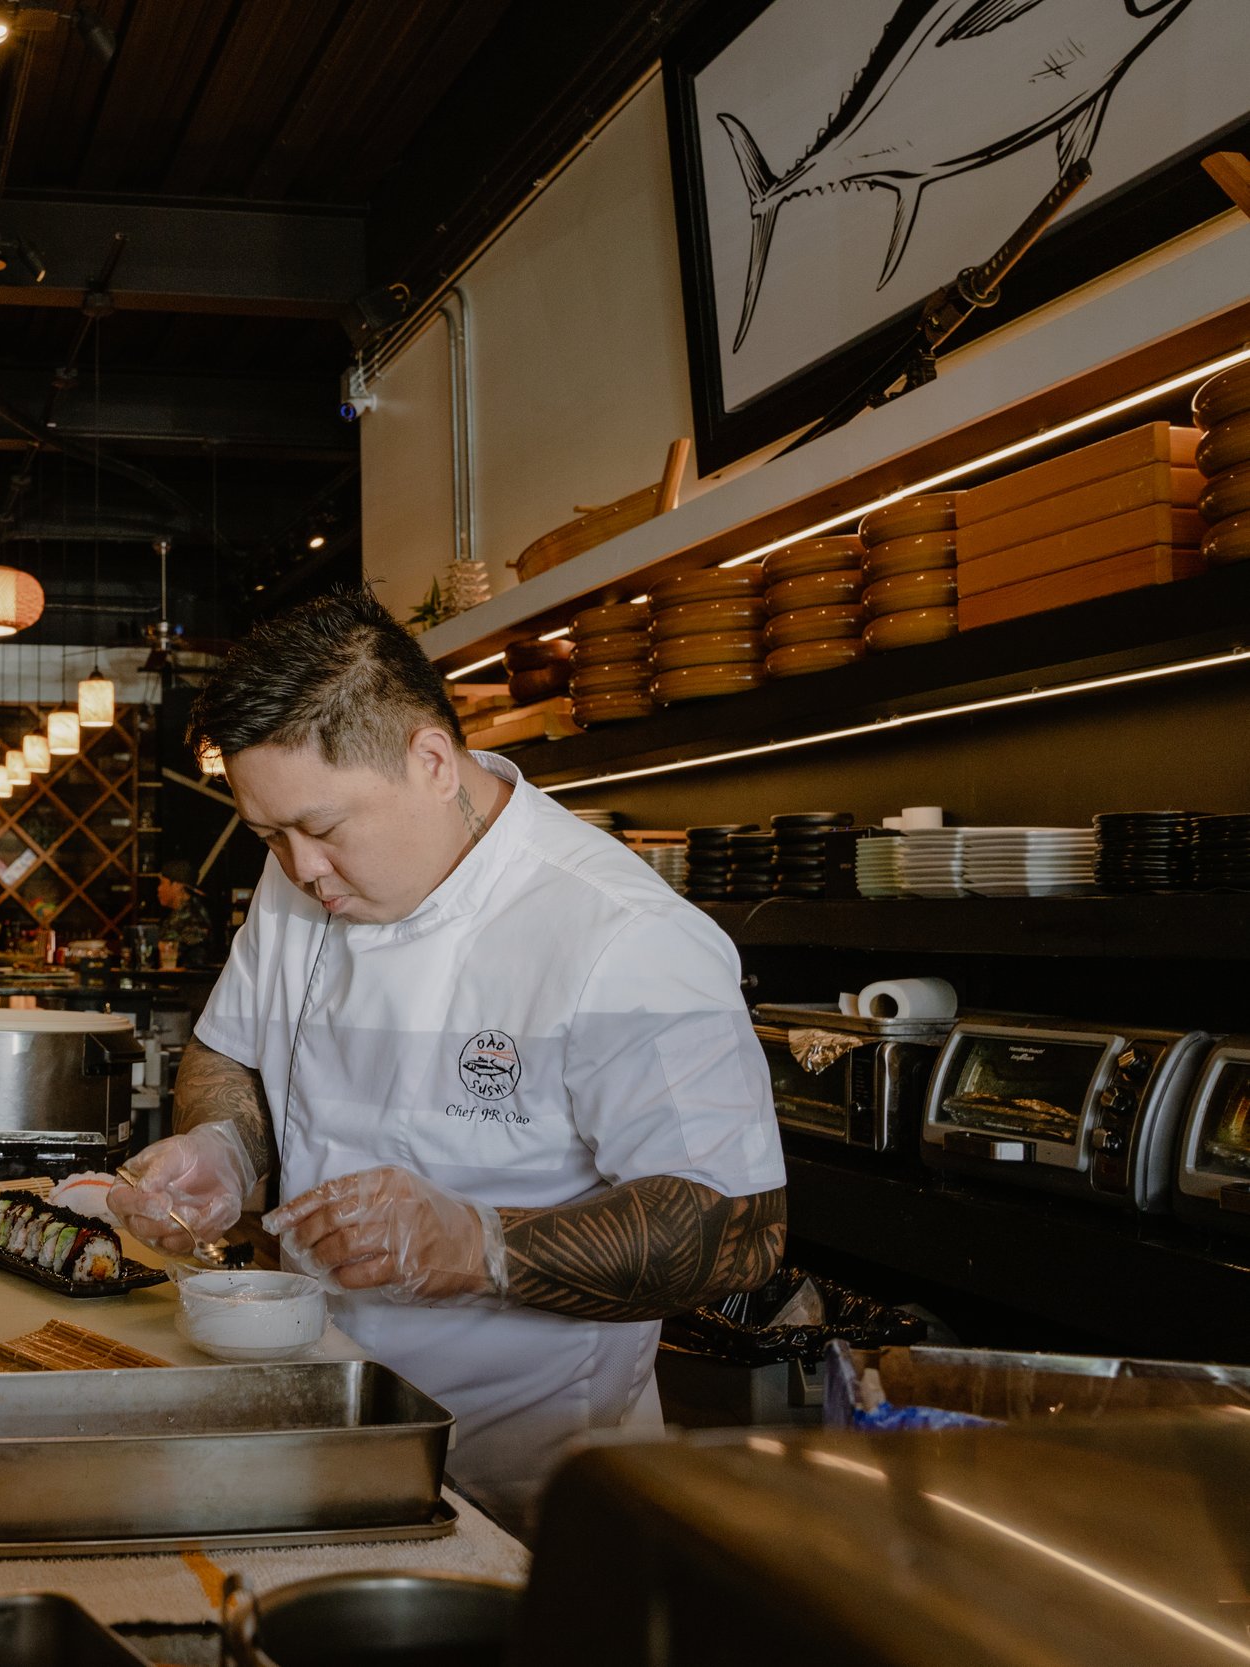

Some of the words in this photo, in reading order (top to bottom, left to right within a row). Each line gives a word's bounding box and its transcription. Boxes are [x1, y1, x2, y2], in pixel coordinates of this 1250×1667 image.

[477, 1032, 505, 1051] OAO
[445, 1103, 478, 1122] Chef
[479, 1108, 503, 1123] JR
[505, 1112, 531, 1126] Oao
